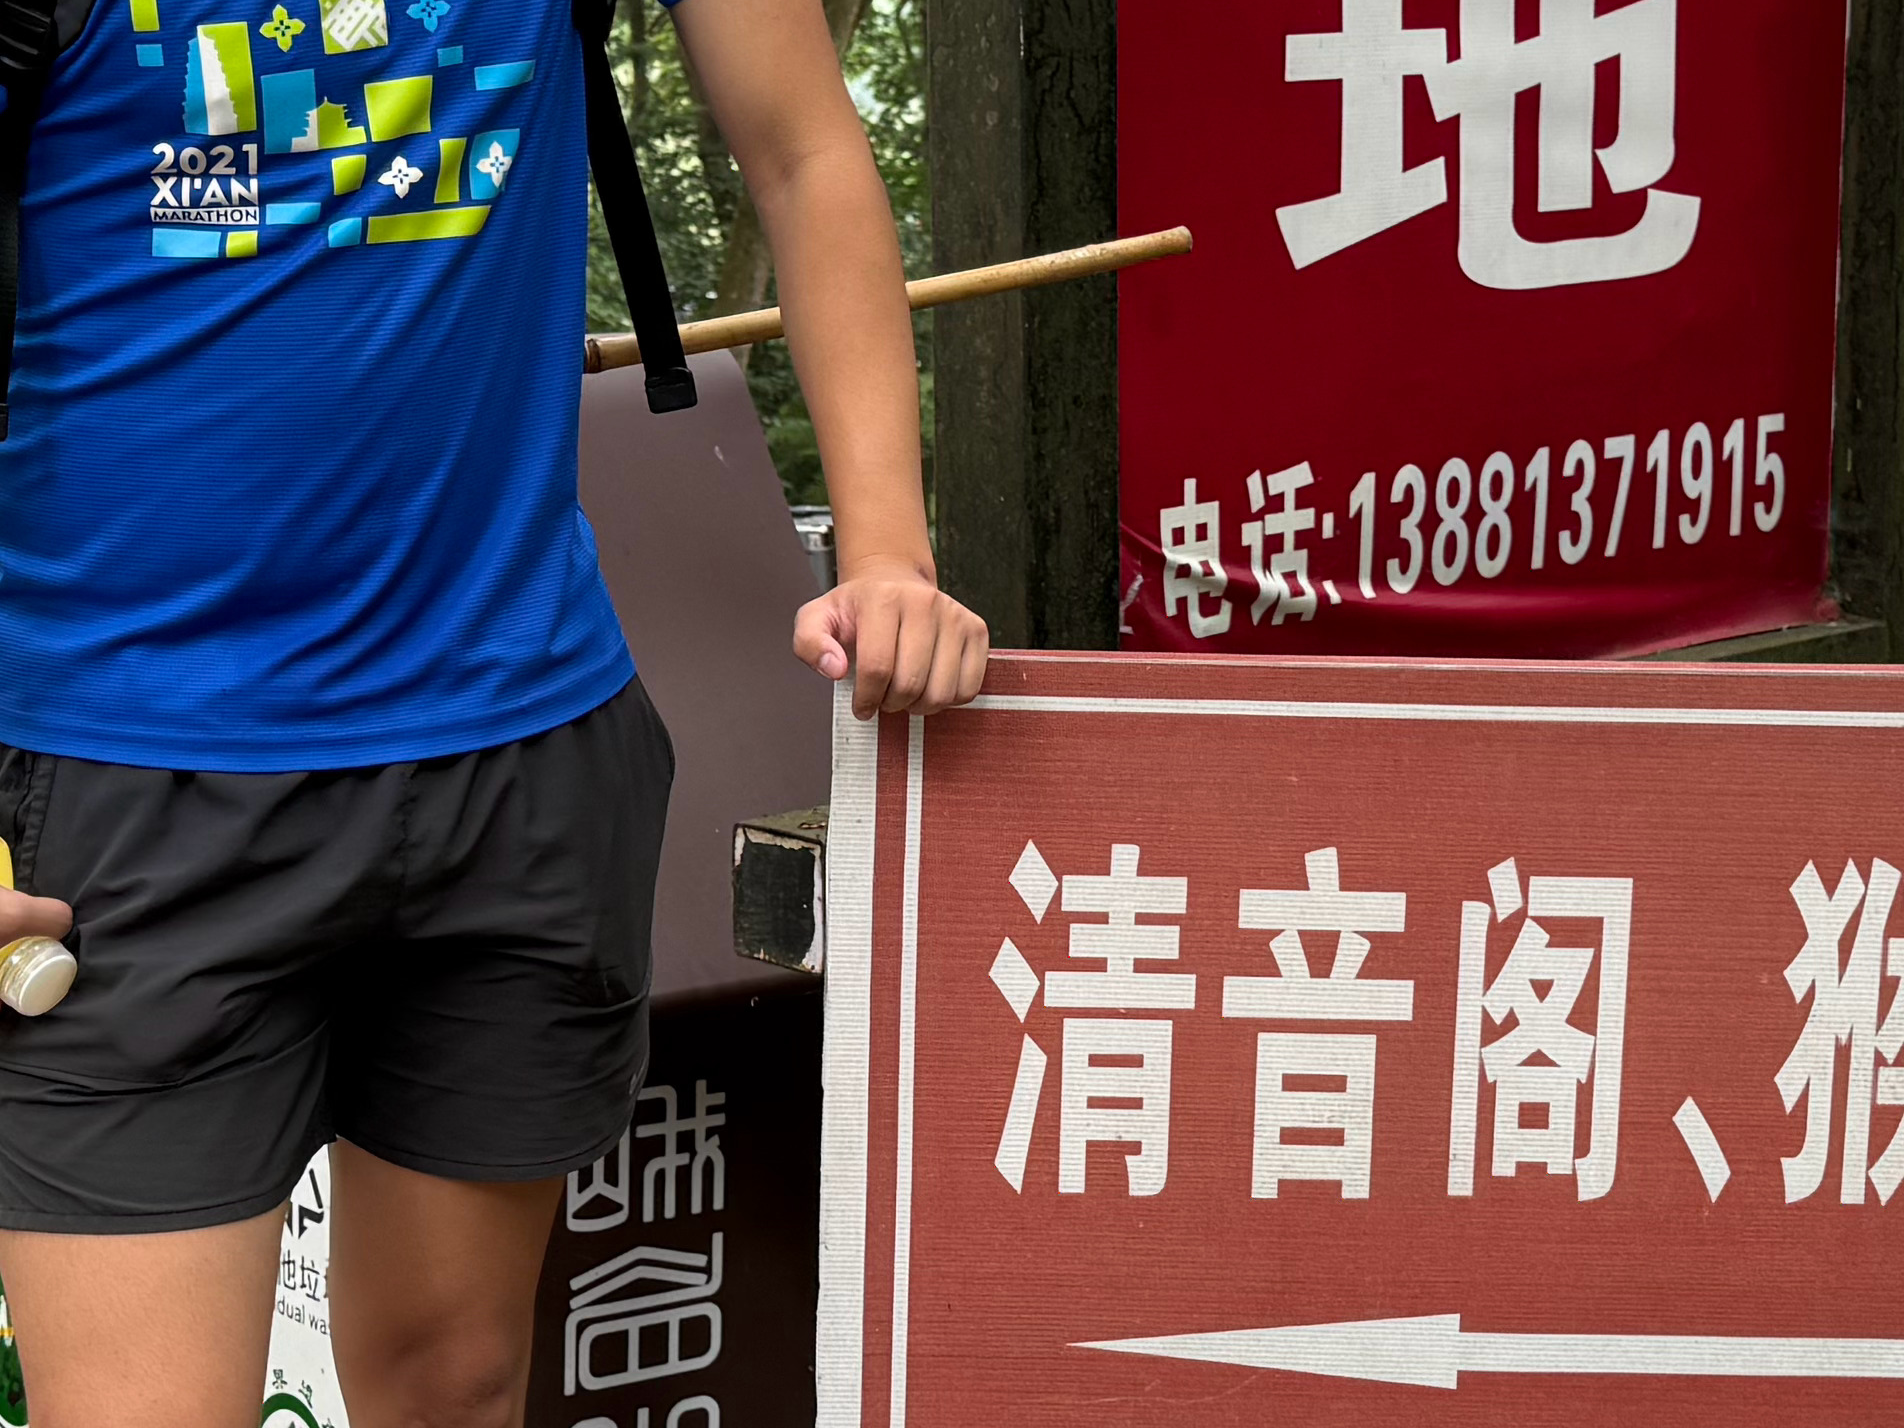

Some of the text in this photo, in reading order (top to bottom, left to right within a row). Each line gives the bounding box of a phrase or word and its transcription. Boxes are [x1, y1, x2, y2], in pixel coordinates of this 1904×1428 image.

[150, 142, 258, 176] 2021
[150, 175, 259, 207] XI'AN
[152, 208, 258, 223] MARATHON
[1159, 412, 1786, 639] 电话:13881371915
